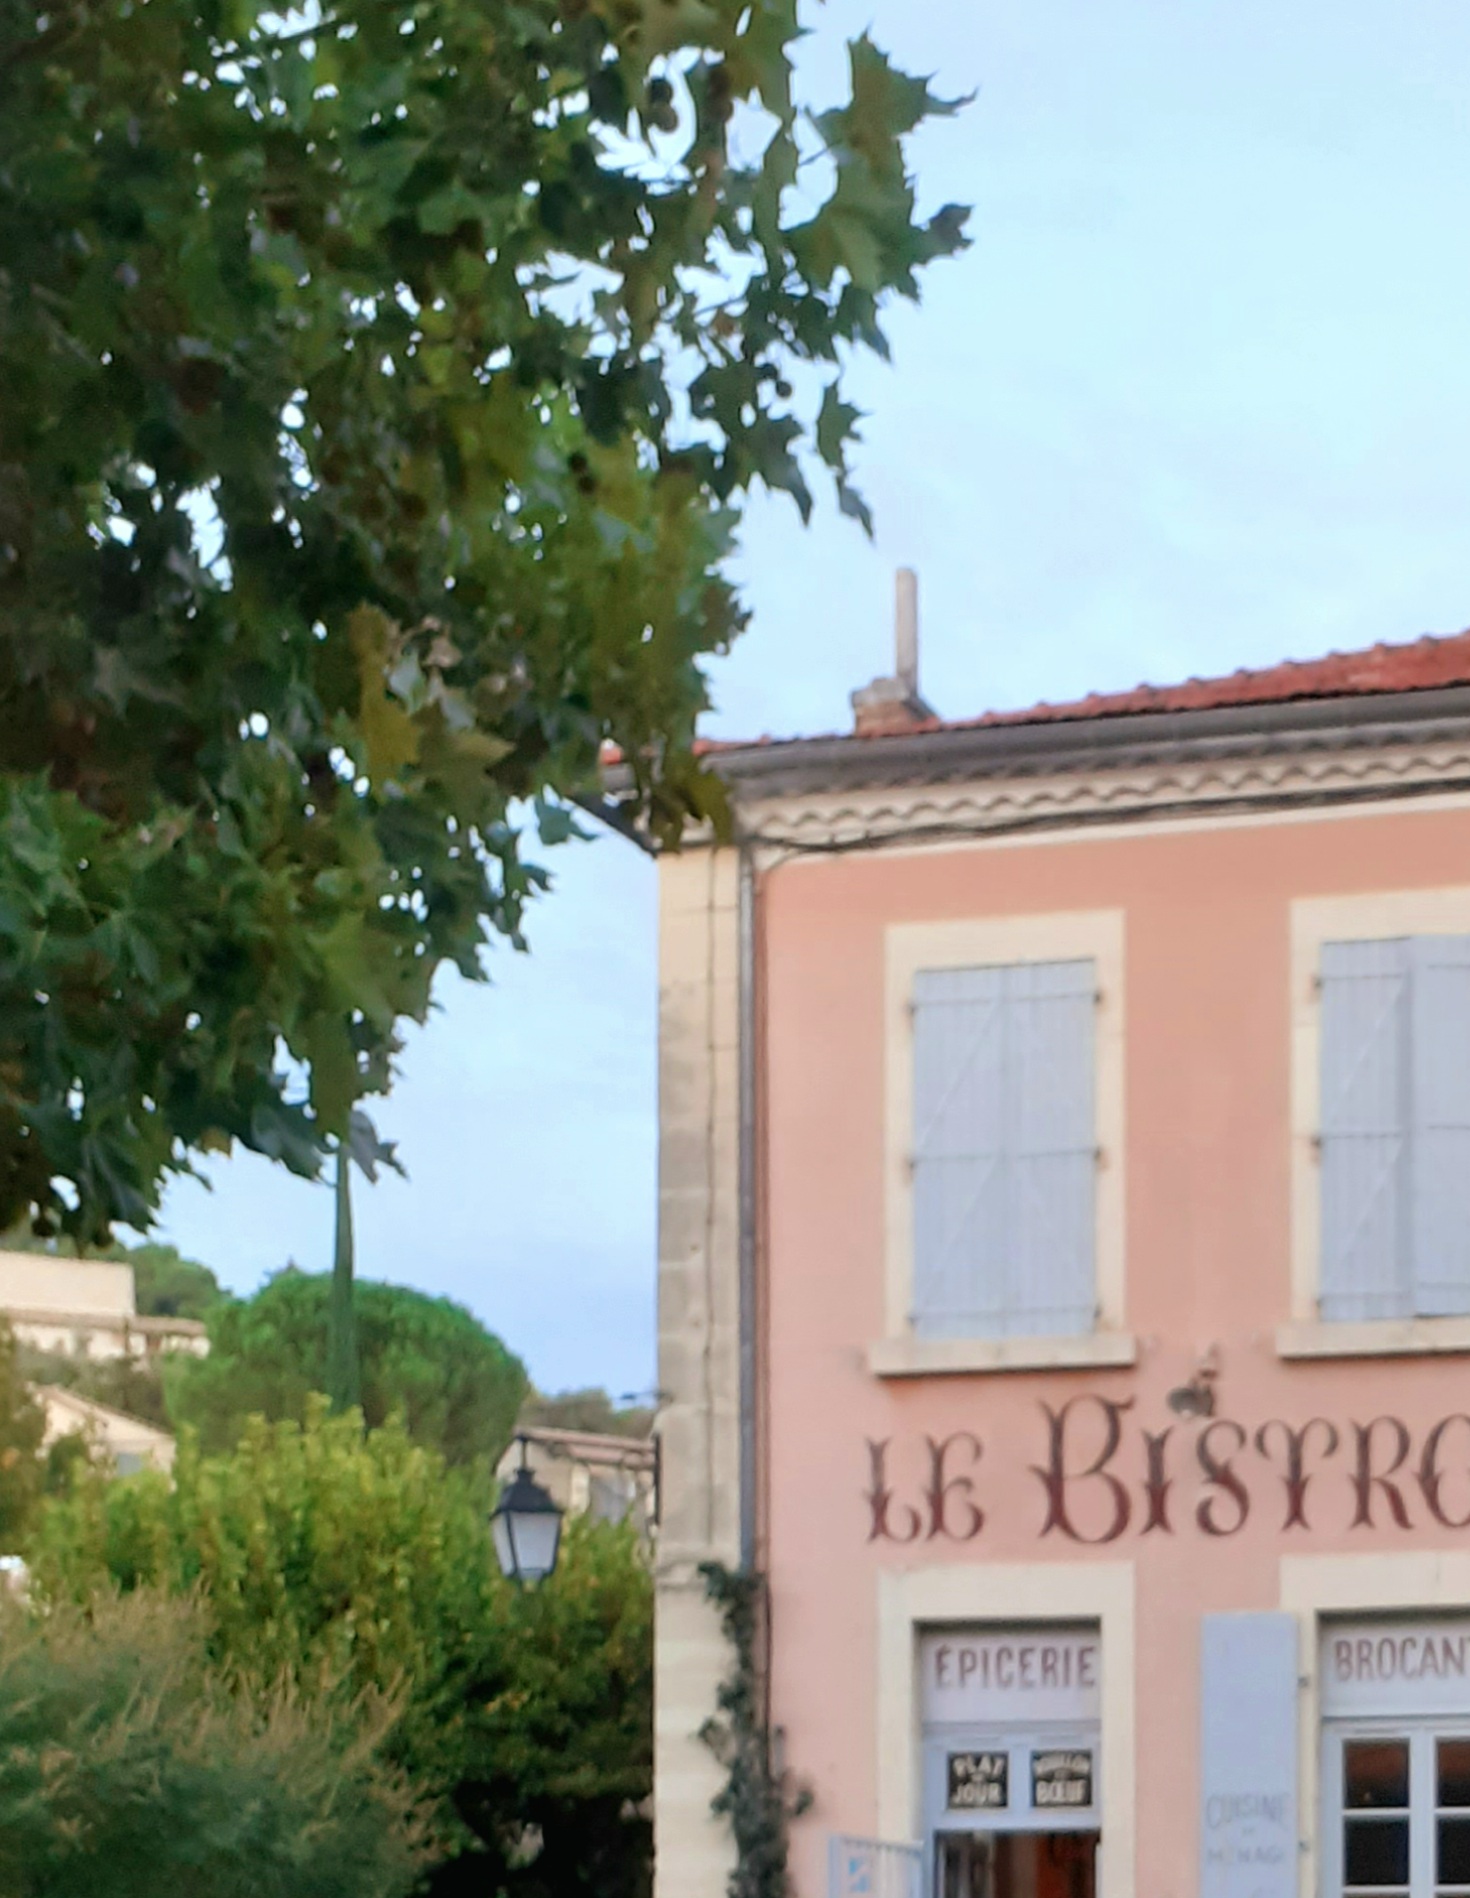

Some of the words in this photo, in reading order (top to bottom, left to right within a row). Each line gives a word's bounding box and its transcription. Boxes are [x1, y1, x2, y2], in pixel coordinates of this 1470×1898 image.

[863, 1431, 985, 1544] LE
[934, 1643, 1096, 1689] ÉPICERIE
[952, 1782, 1001, 1805] JOUR
